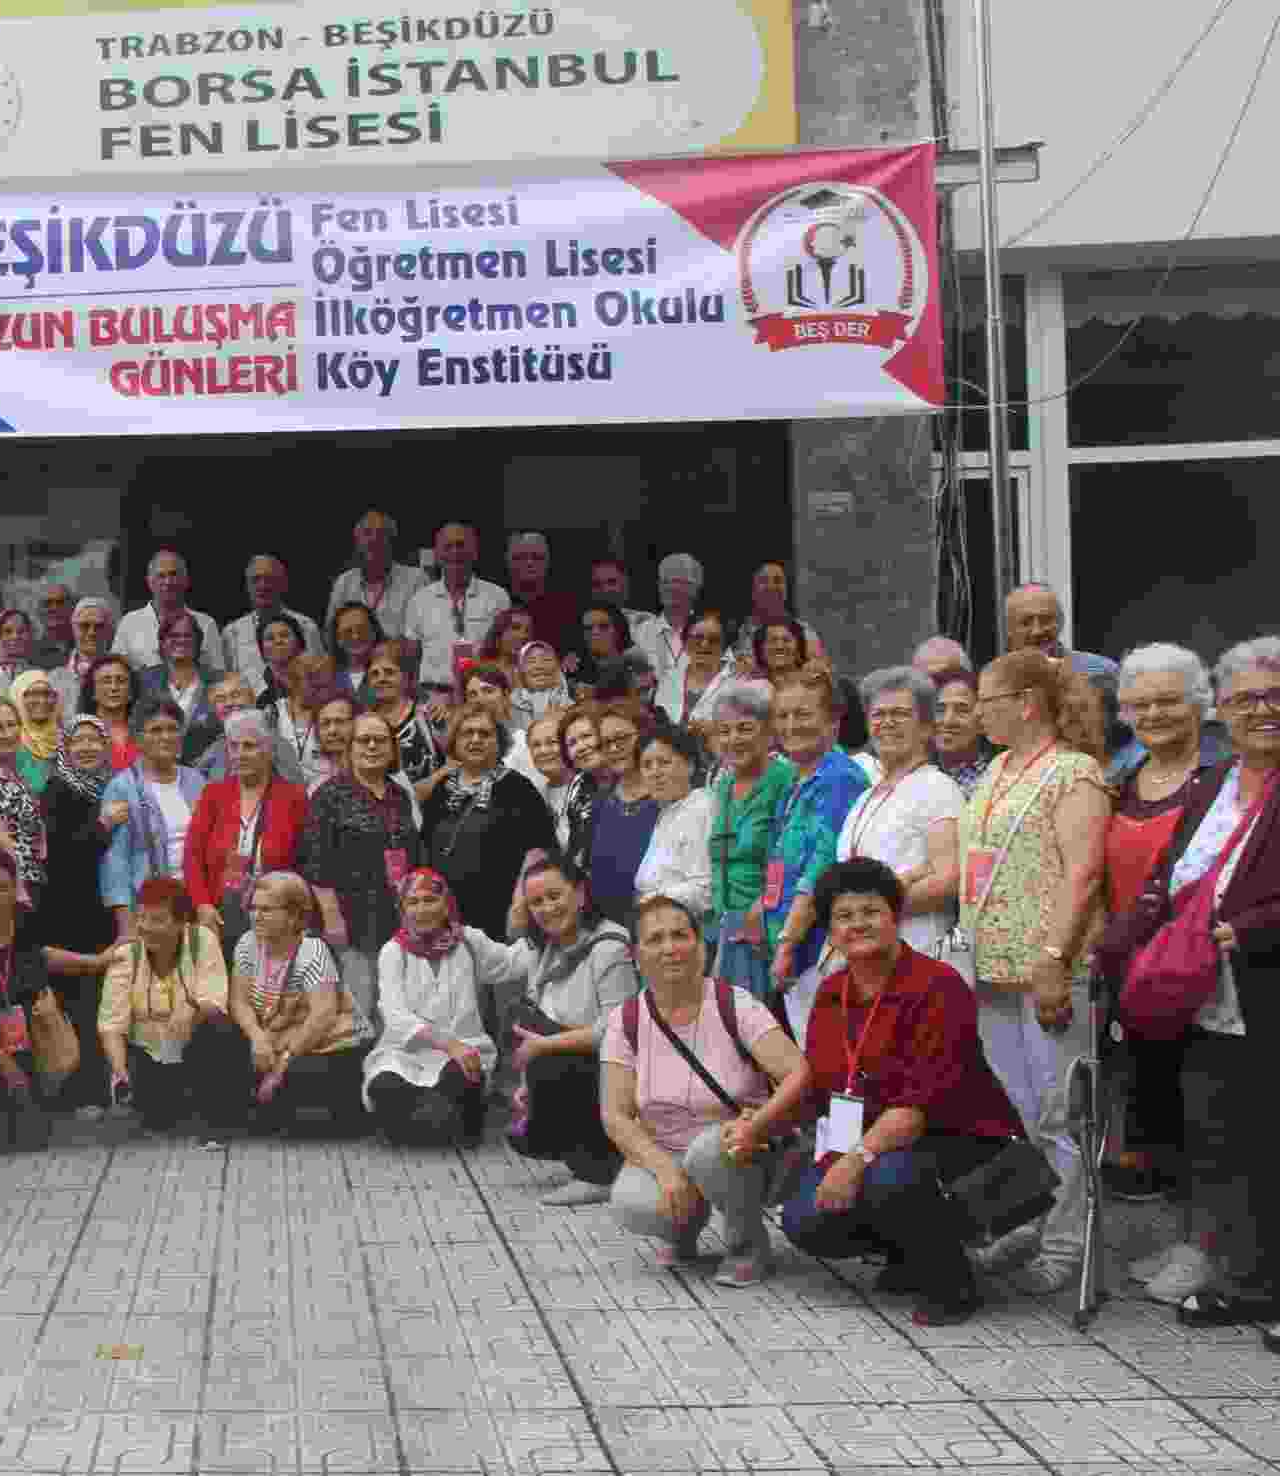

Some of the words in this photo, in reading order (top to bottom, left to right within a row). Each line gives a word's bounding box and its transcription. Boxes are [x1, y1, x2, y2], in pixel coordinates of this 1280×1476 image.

[97, 26, 284, 60] TRABZON
[324, 9, 554, 52] BEŞİKDÜZÜ
[99, 65, 325, 111] BORSA
[347, 49, 679, 98] İSTANBUL
[100, 120, 223, 160] FEN
[246, 103, 443, 152] LİSESİ
[312, 202, 387, 236] Fen
[407, 196, 519, 230] Lisesi
[312, 241, 526, 291] Öğretmen
[545, 238, 656, 278] Lisesi
[89, 302, 297, 350] BULUŞMA
[314, 290, 576, 343] İlköğretmen
[595, 290, 724, 329] Okulu
[834, 321, 870, 337] DER
[110, 346, 298, 398] GÜNLERİ
[317, 348, 399, 396] Köy
[418, 342, 612, 388] Enstitüsü
